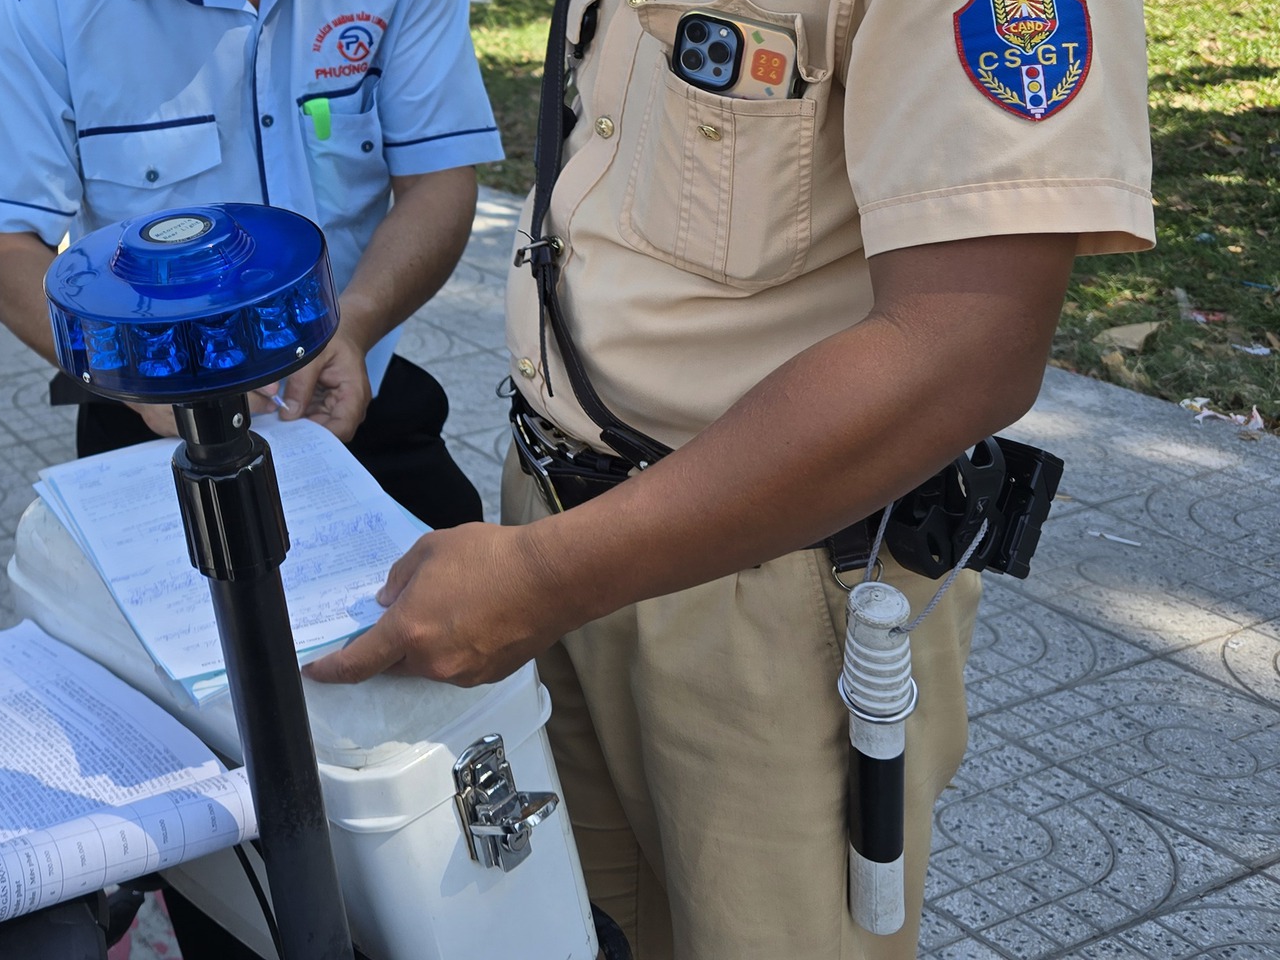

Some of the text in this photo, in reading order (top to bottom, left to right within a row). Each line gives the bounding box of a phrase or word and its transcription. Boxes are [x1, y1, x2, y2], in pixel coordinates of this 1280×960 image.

[1010, 21, 1043, 32] CAND
[314, 62, 368, 80] PHƯƠNG
[76, 841, 86, 867] 700.000
[119, 829, 129, 856] 700.000
[44, 850, 54, 877] 700.000
